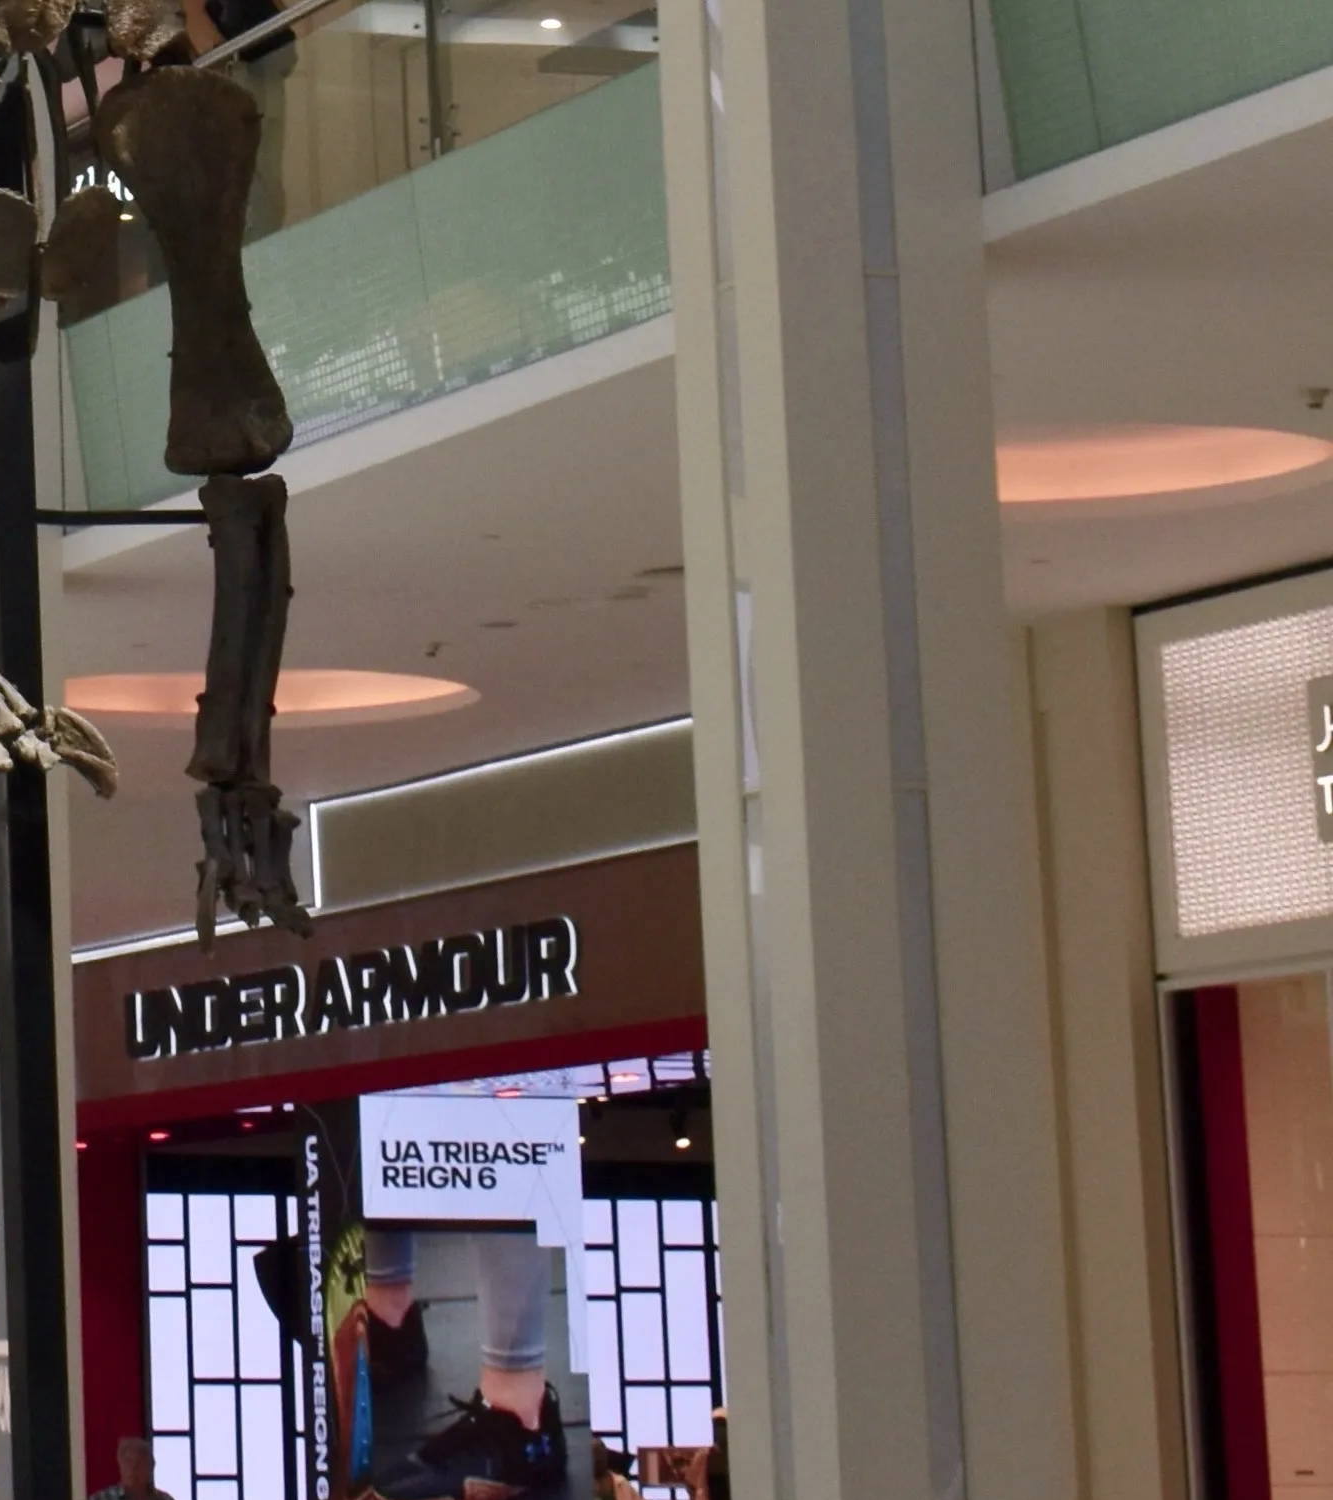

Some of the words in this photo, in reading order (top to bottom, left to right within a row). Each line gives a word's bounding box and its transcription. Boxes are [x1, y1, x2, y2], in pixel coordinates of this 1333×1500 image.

[124, 963, 308, 1062] UNDER
[308, 914, 581, 1034] ARMOUR
[380, 1140, 429, 1165] UA
[381, 1166, 472, 1190] REIGN
[477, 1166, 498, 1190] 6
[304, 1135, 319, 1188] UA
[312, 1361, 329, 1473] REIGN
